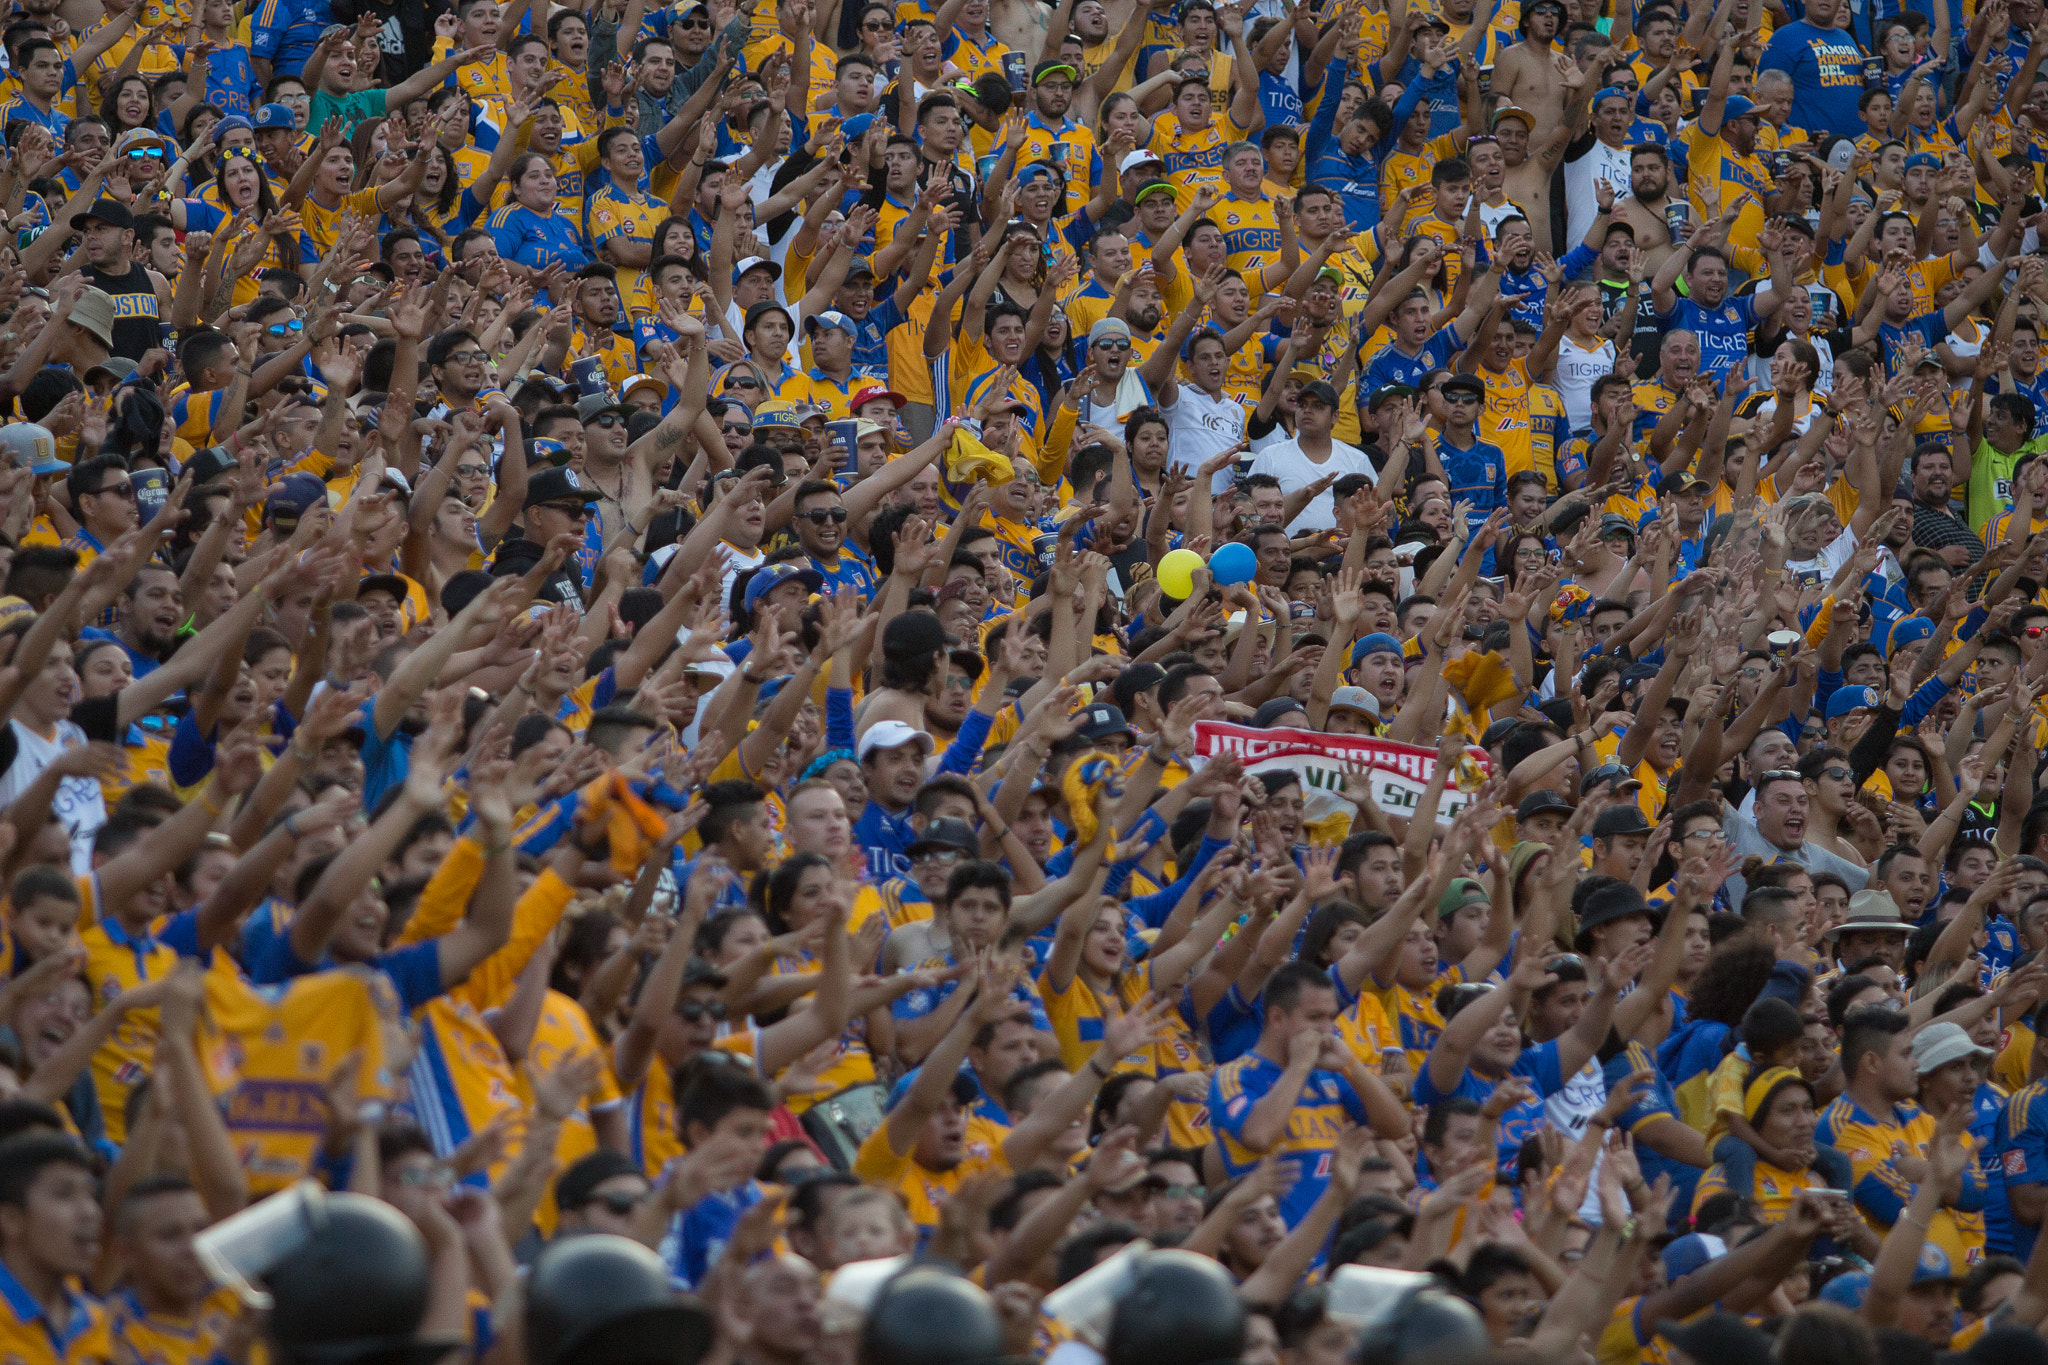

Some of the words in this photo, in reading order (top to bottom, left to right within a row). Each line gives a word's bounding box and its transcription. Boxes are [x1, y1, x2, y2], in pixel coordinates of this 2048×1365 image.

[1808, 37, 1828, 47] LA
[1813, 43, 1858, 56] FAMOSA
[1818, 65, 1845, 76] DEL
[1820, 75, 1863, 87] CAMPE
[1268, 91, 1303, 114] TIGR
[1227, 231, 1282, 252] TIGRE
[114, 294, 158, 316] USTON
[1530, 417, 1555, 432] RES
[832, 436, 846, 445] ona
[1286, 1112, 1346, 1141] UAN
